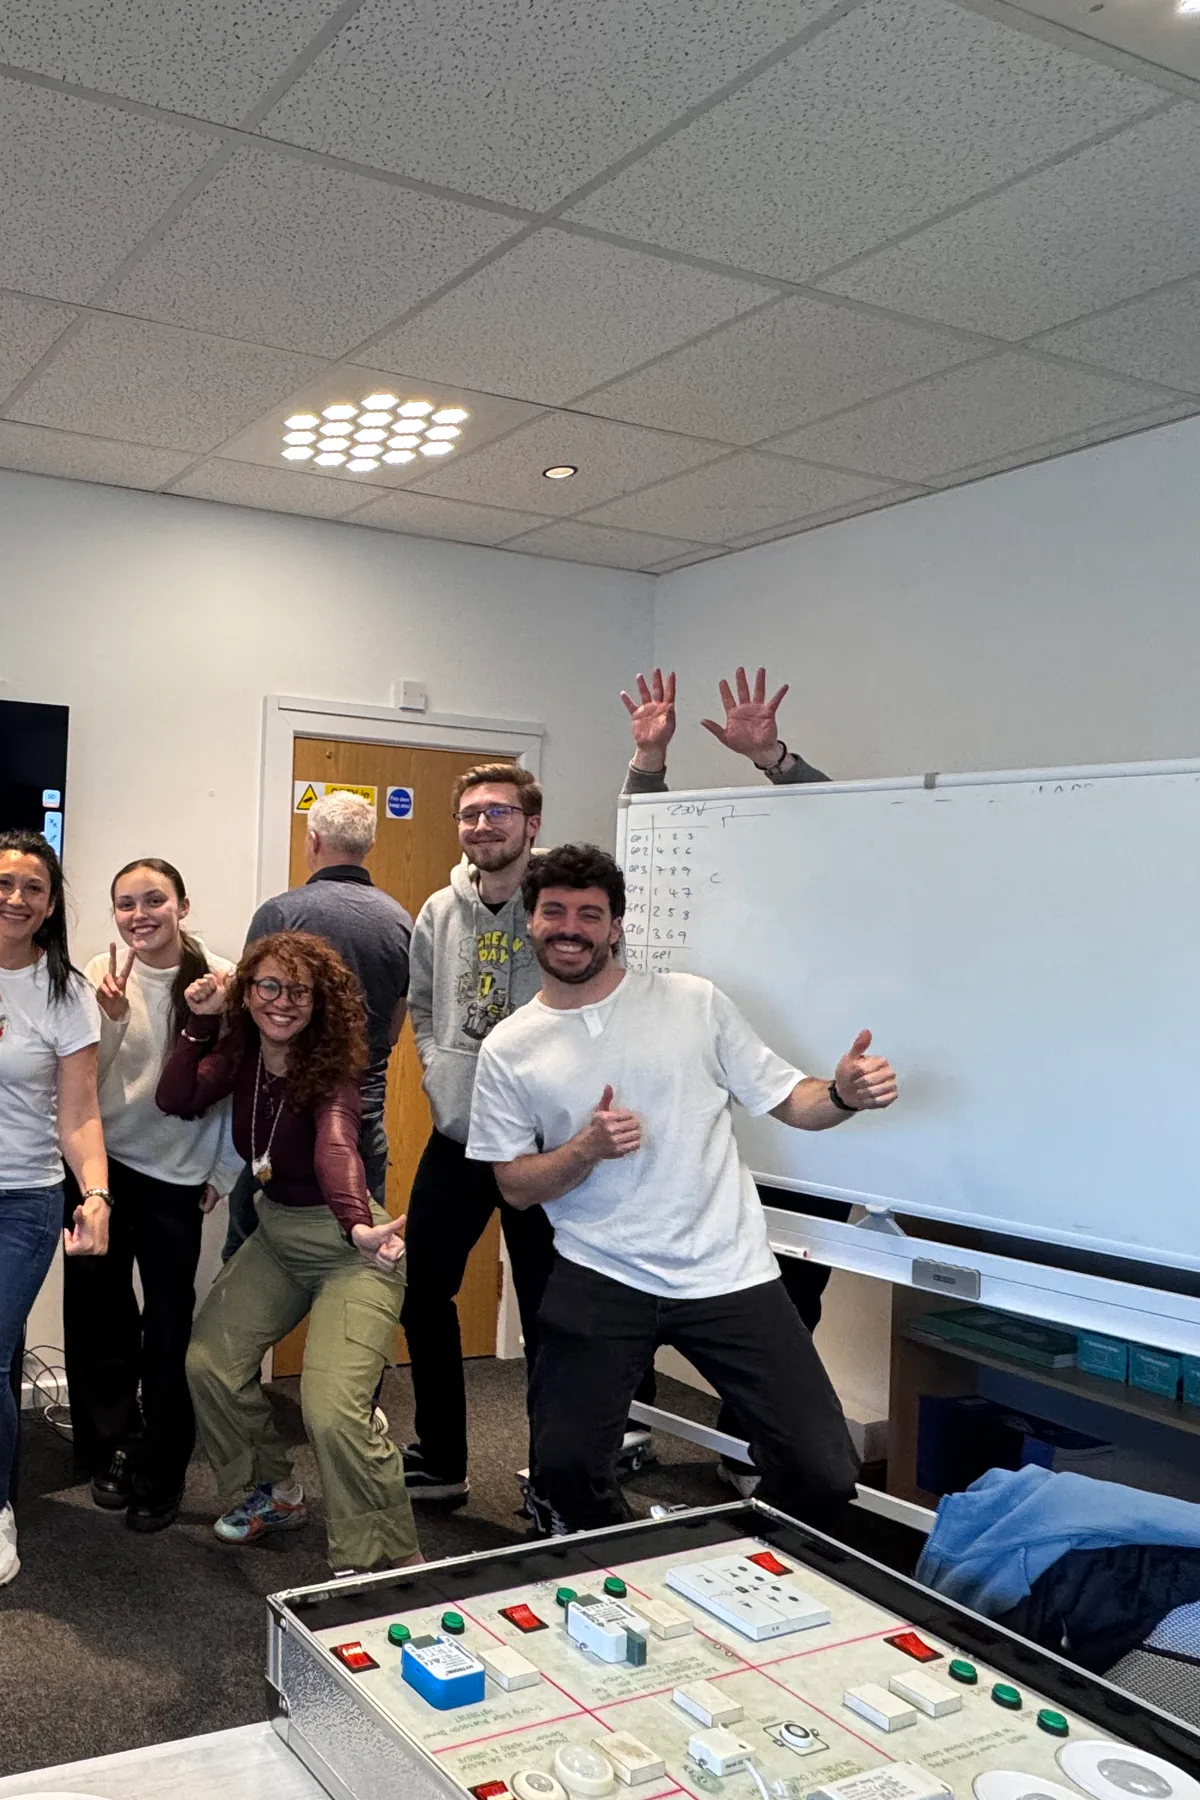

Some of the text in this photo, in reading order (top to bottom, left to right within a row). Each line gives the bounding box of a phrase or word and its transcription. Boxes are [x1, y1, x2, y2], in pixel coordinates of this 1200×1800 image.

[656, 847, 664, 855] 4
[673, 846, 680, 855] 5
[685, 847, 692, 855] 6
[669, 888, 679, 898] 4
[681, 887, 692, 898] 7
[653, 906, 661, 917] 2
[668, 907, 676, 917] 5
[683, 910, 690, 921] 8
[652, 928, 661, 939] 3
[666, 929, 674, 939] 6
[678, 931, 687, 944] 9
